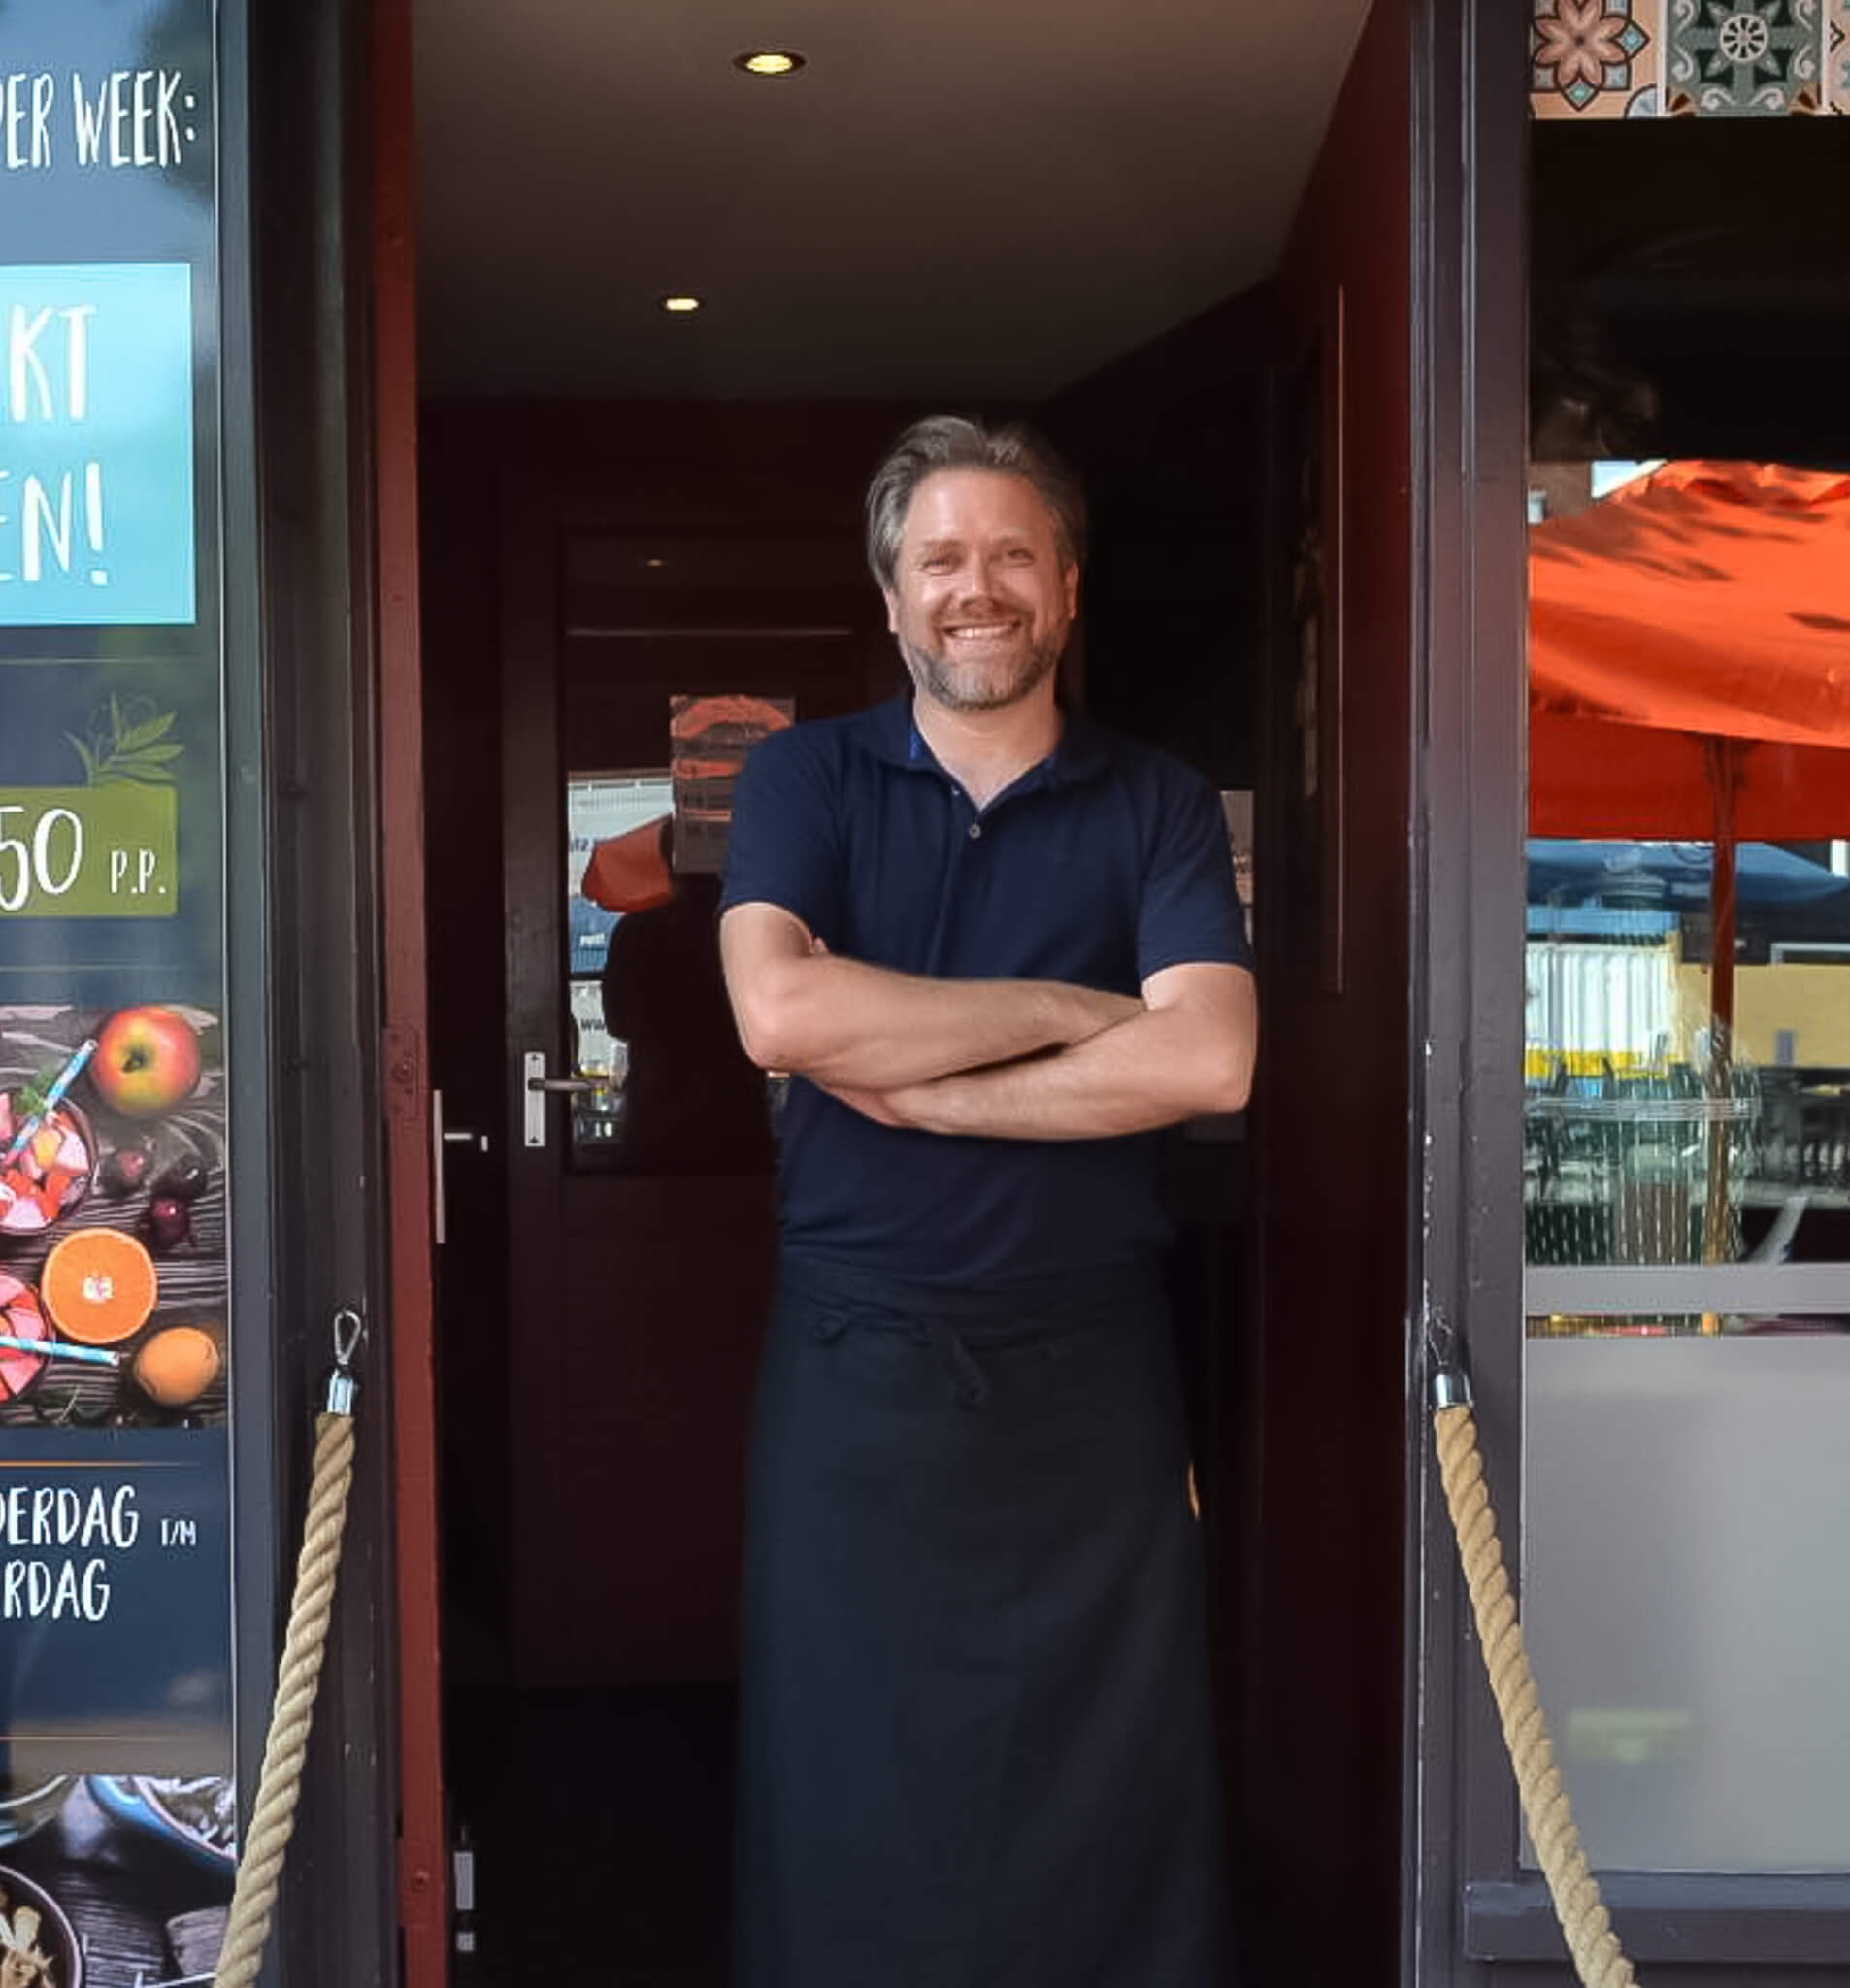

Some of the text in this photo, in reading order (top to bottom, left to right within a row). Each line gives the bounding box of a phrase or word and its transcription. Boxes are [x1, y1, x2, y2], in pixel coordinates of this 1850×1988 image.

[0, 70, 195, 169] ER WEEK:
[10, 303, 98, 423] KT
[111, 847, 167, 894] P.P.
[4, 1558, 110, 1622] RDAG
